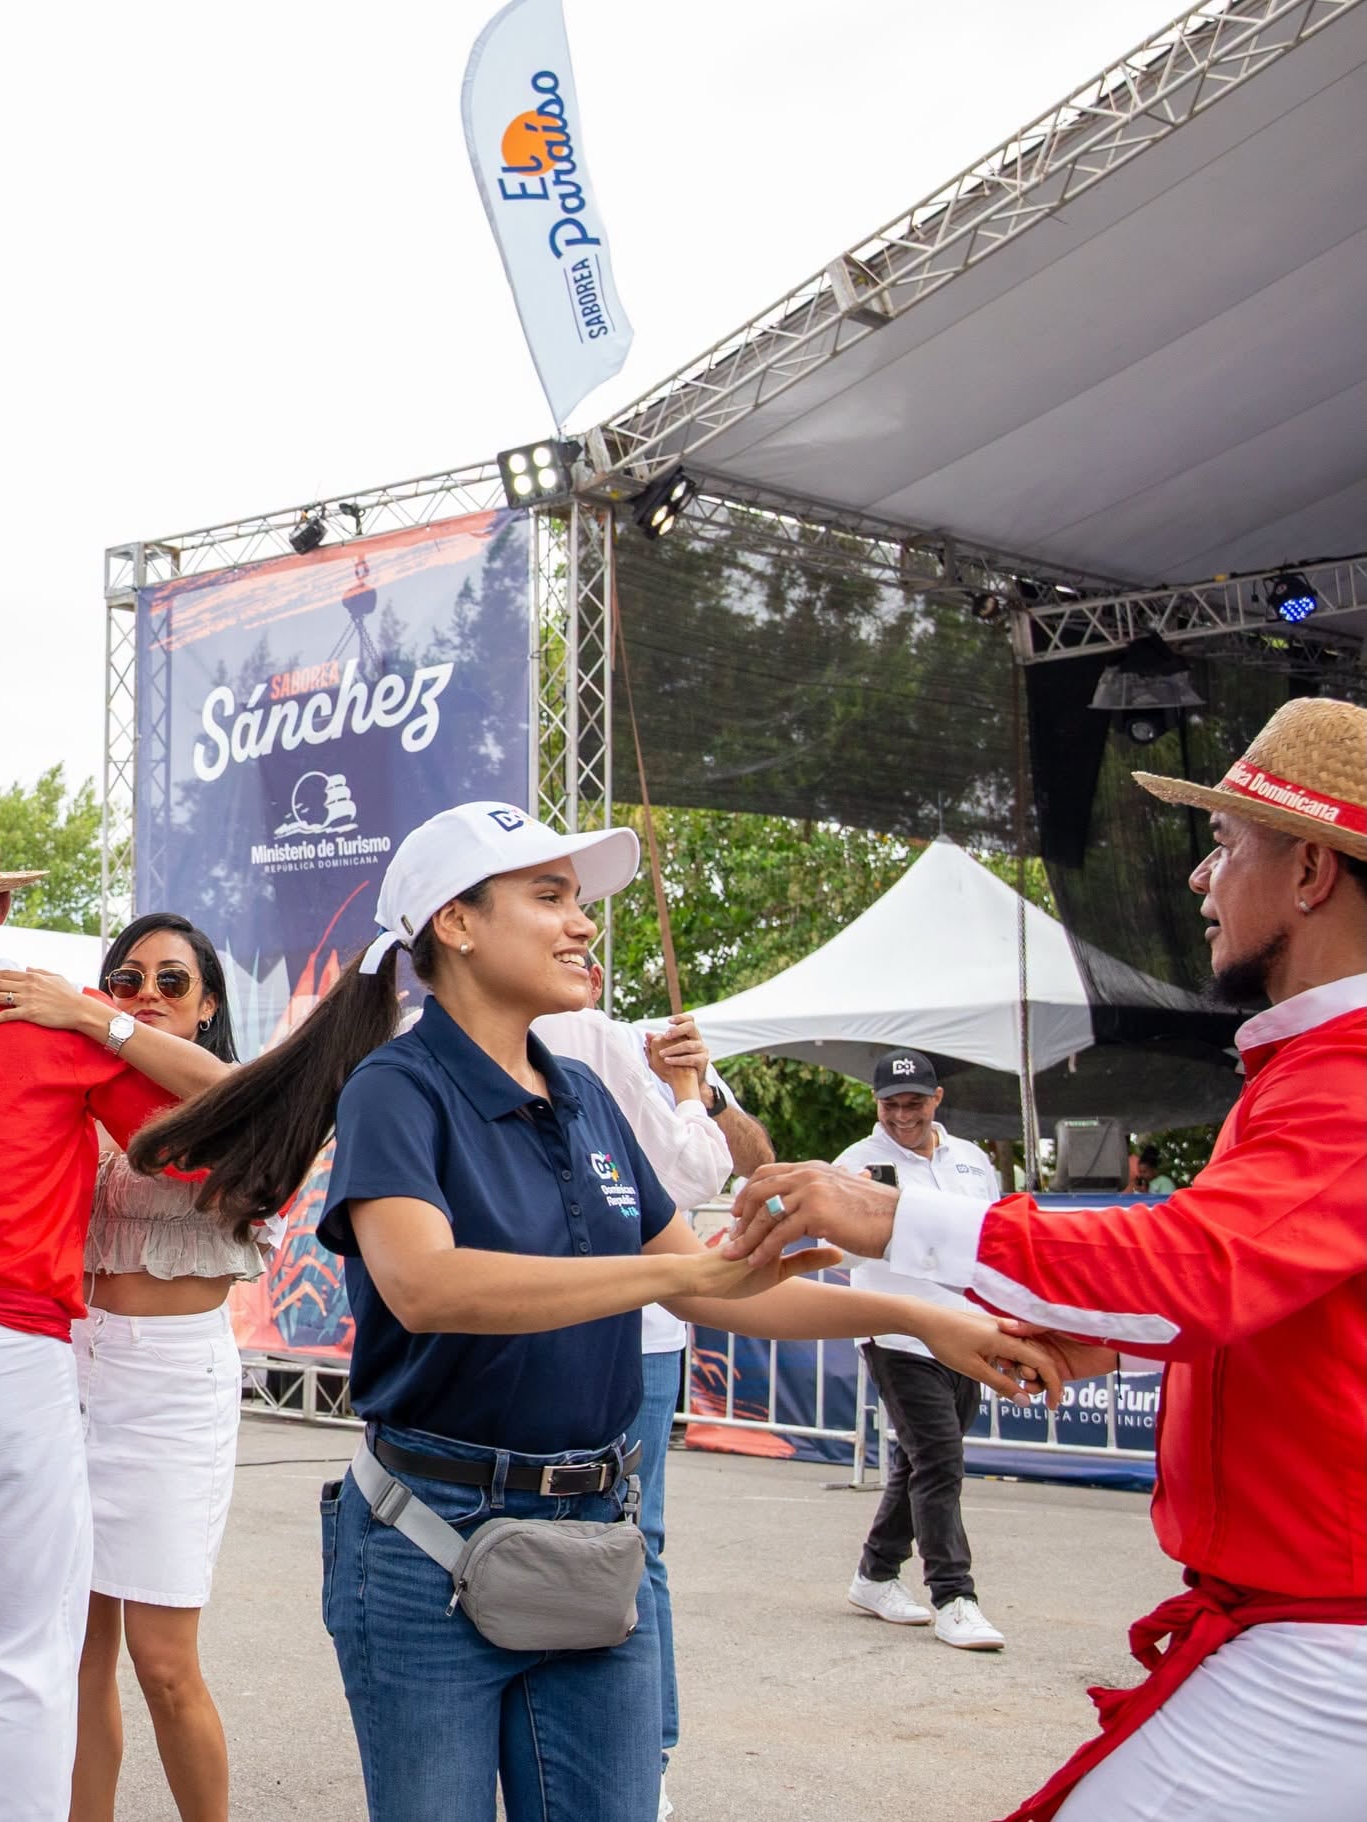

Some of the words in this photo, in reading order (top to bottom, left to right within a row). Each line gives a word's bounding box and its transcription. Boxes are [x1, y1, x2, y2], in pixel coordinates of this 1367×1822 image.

[498, 155, 550, 201] El
[524, 70, 601, 260] Paraíso
[572, 257, 608, 340] SABOREA
[270, 658, 340, 700] SABOREA
[193, 658, 454, 782] Sánchez
[1248, 773, 1340, 822] Dominicana
[250, 841, 316, 864] Ministerio
[317, 839, 334, 857] de
[335, 835, 391, 856] Turismo
[318, 855, 379, 869] DOMINICANA
[1078, 1382, 1109, 1408] de
[1115, 1383, 1161, 1412] Turi
